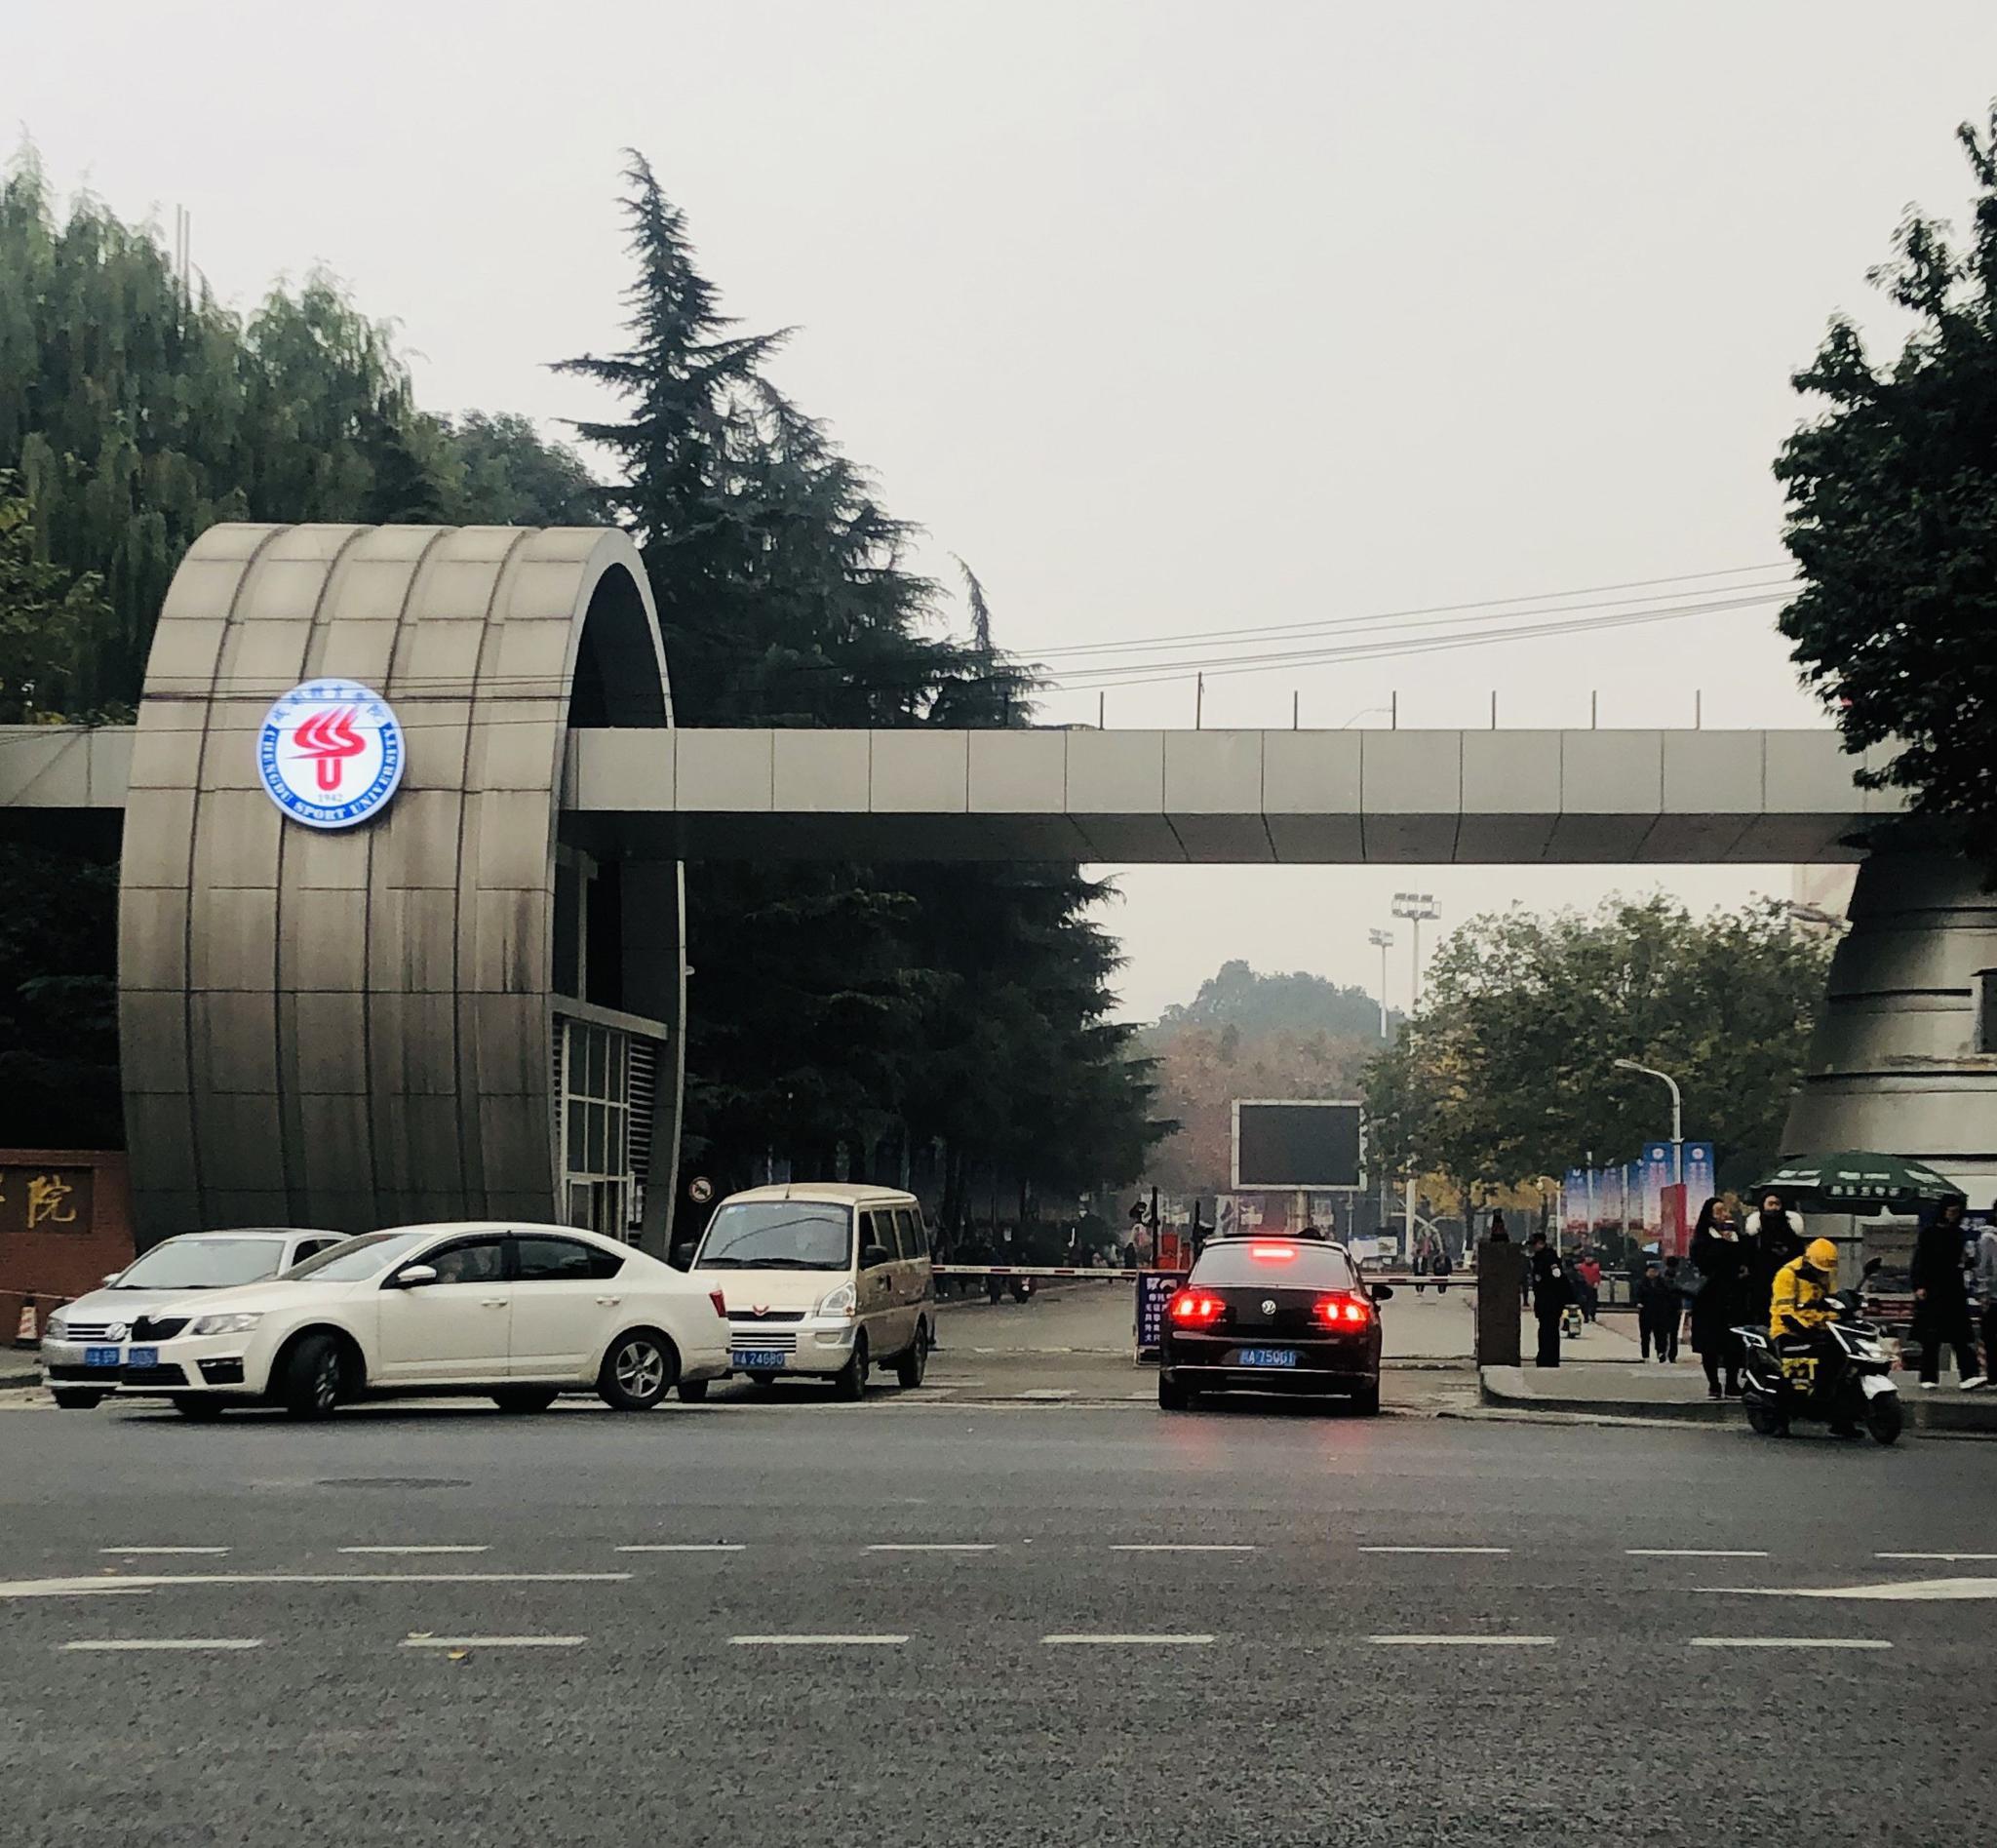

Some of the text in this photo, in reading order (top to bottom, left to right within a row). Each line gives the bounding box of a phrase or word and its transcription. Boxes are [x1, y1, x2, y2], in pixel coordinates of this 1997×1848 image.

[262, 728, 398, 820] CHENGDU SPORT UNIVERSITY
[0, 1173, 77, 1229] 院
